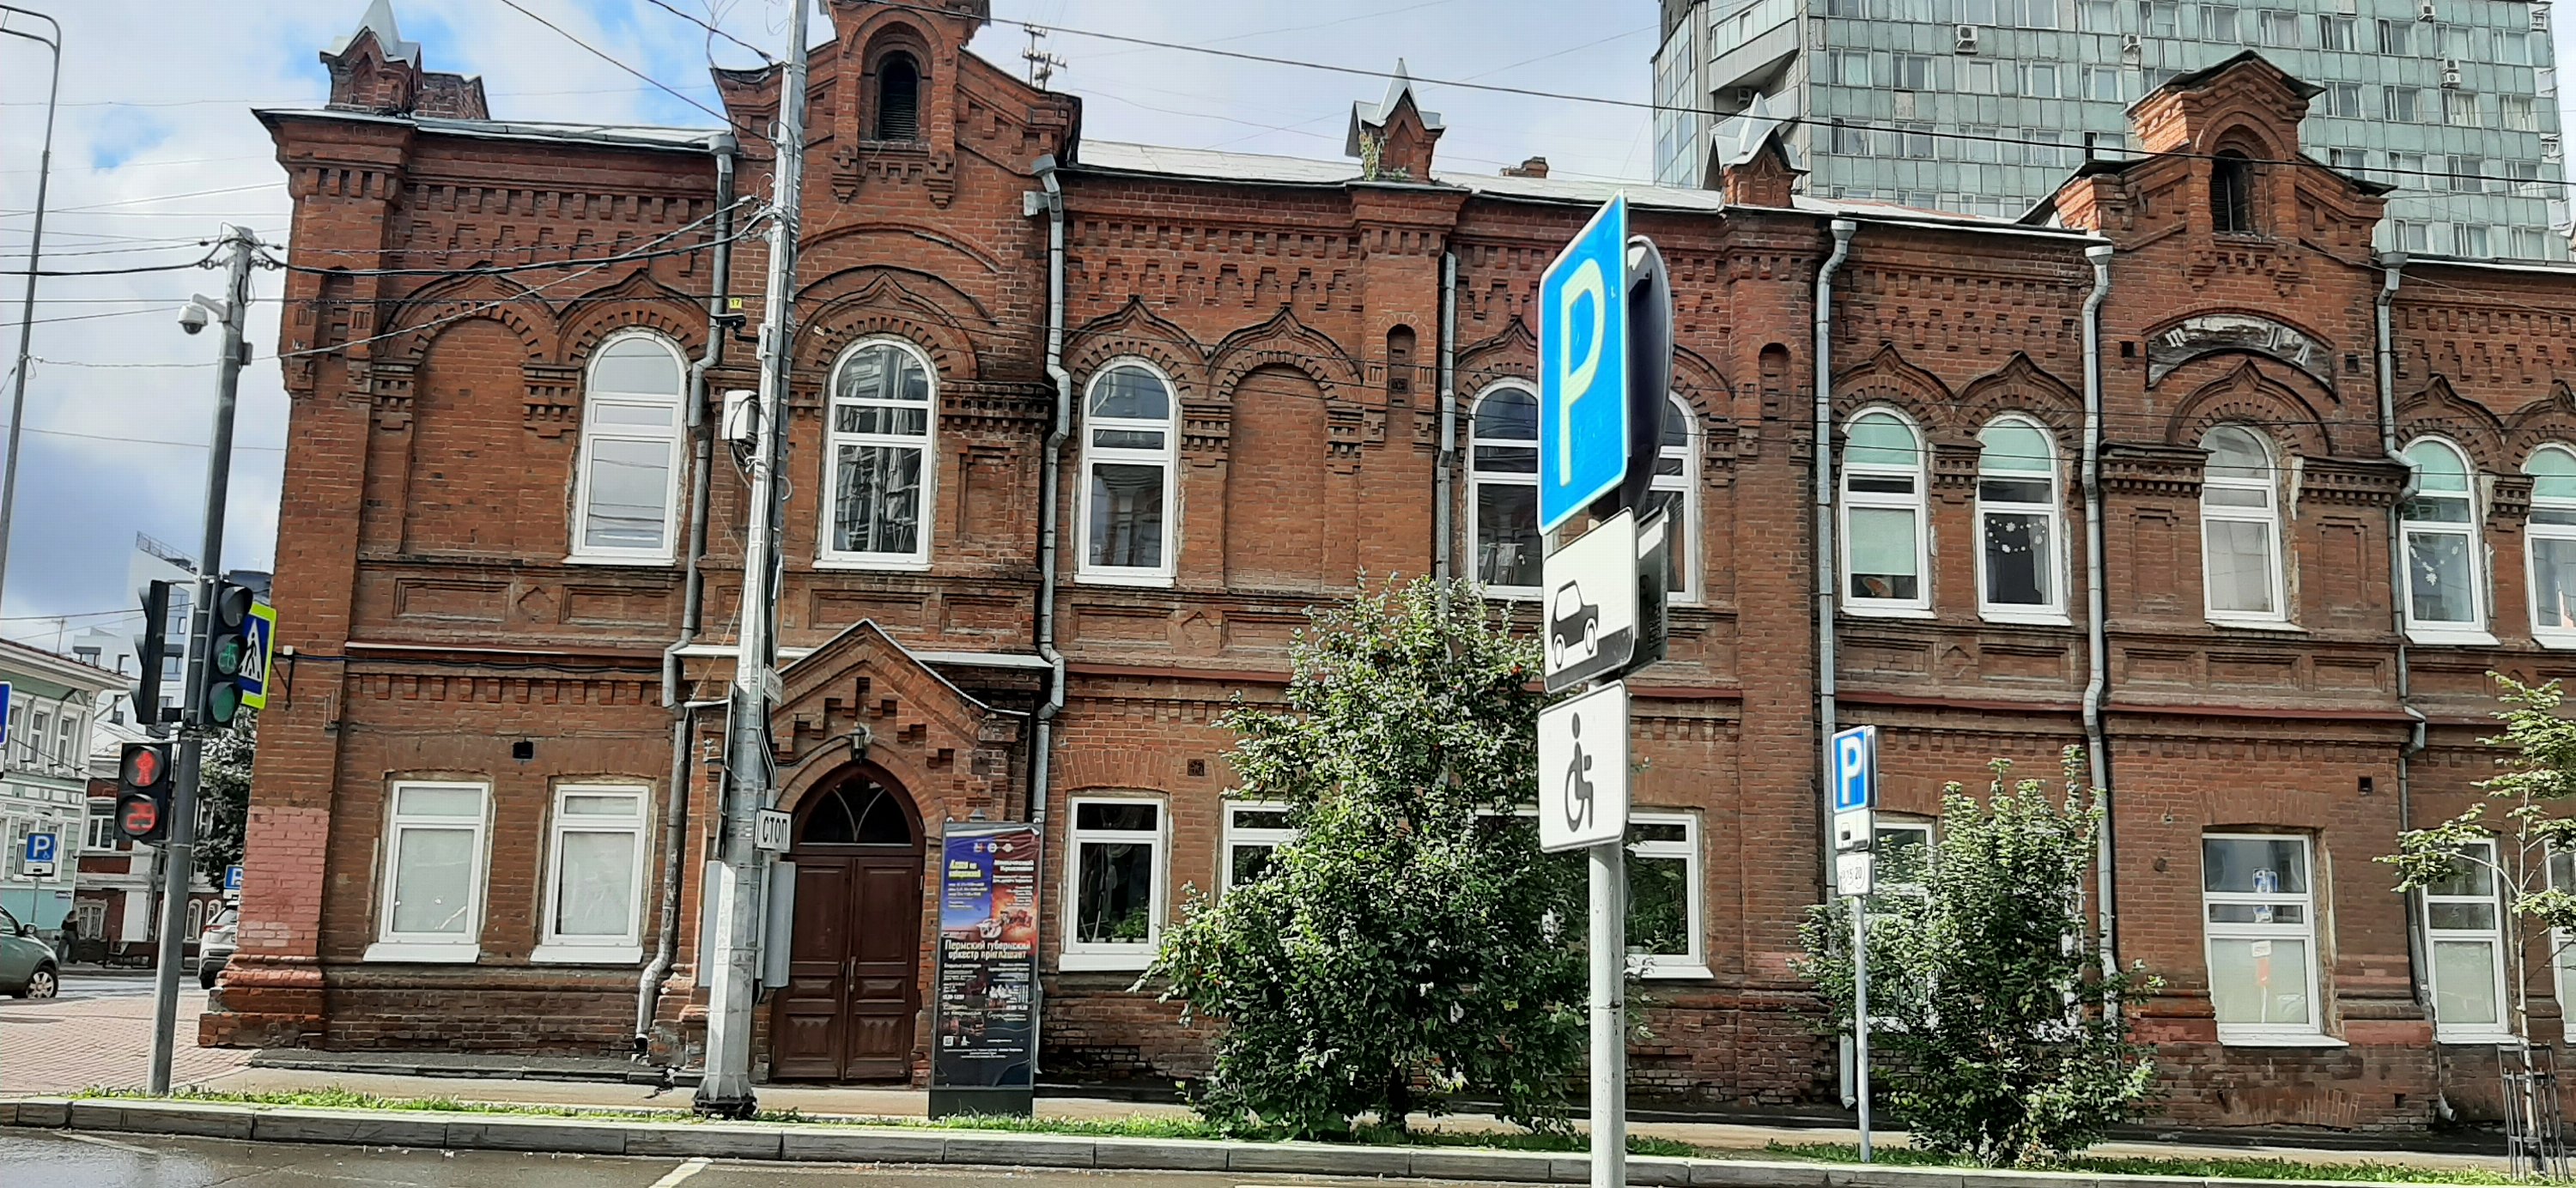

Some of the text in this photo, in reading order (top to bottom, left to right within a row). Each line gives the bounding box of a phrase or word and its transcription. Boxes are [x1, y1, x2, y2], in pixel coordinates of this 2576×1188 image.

[1559, 258, 1605, 487] P
[1839, 736, 1863, 805] P
[762, 816, 787, 845] СТОП
[33, 835, 51, 858] P
[945, 939, 985, 952] Пермский
